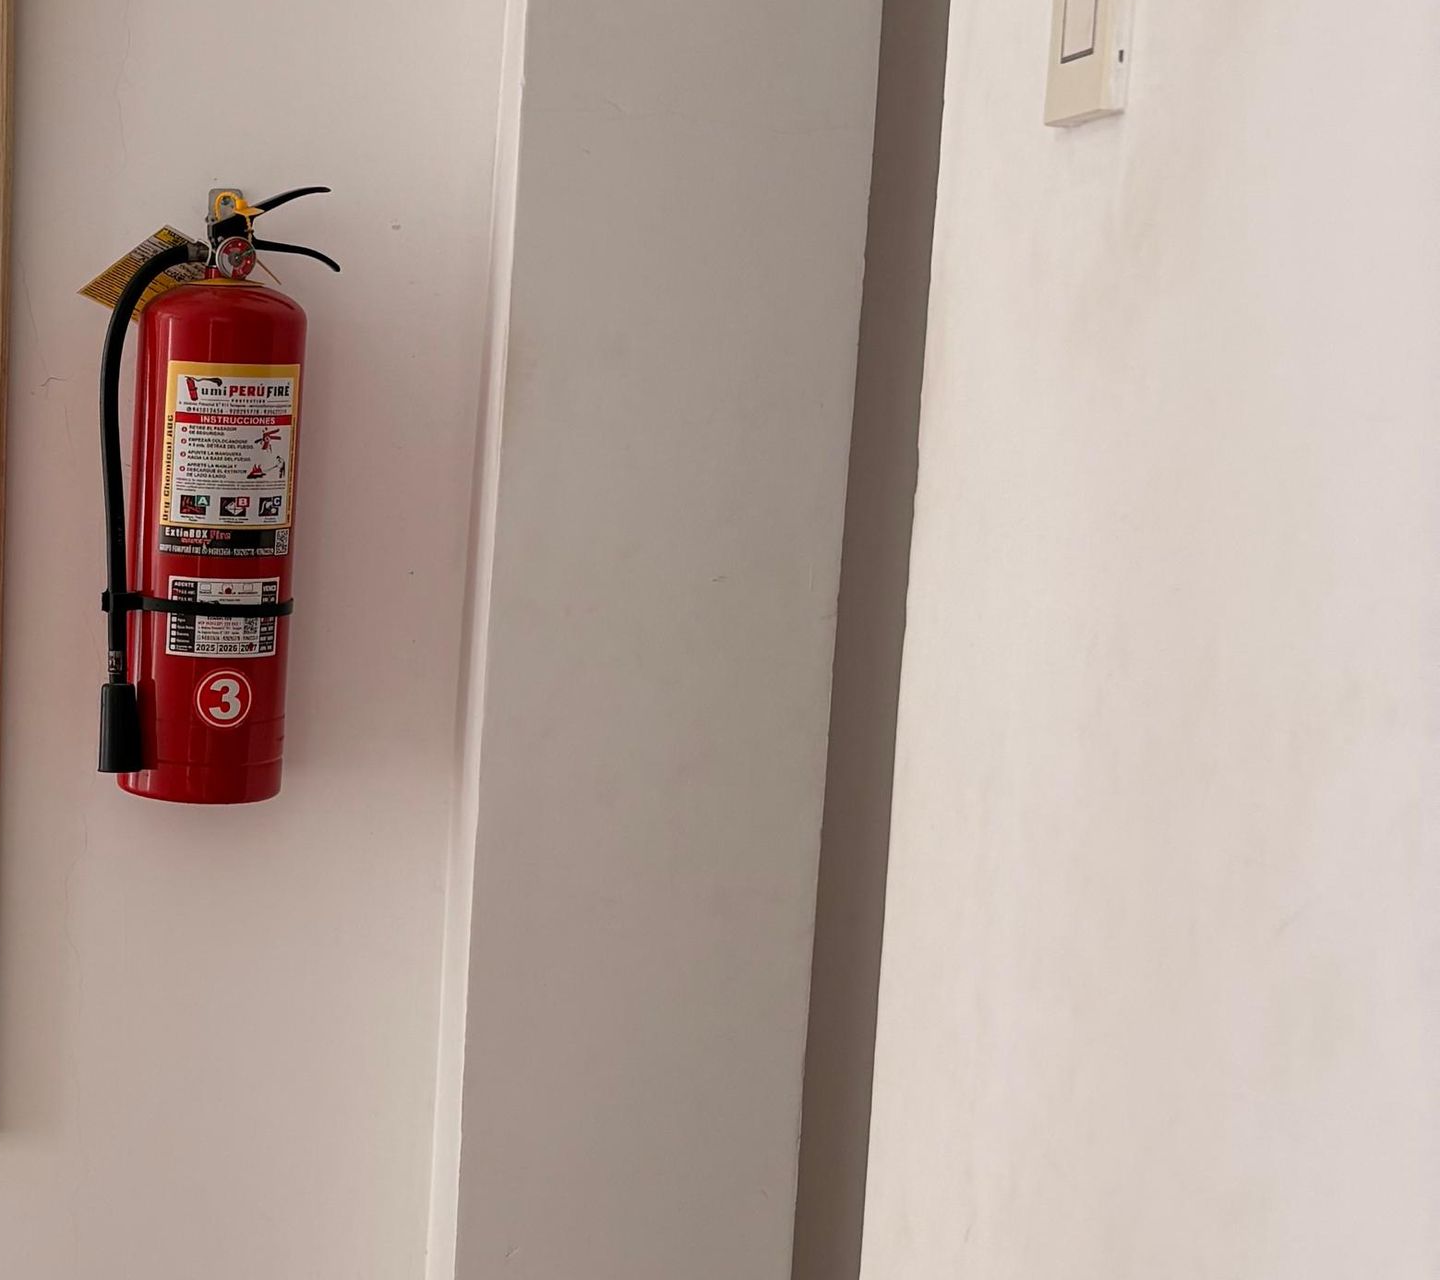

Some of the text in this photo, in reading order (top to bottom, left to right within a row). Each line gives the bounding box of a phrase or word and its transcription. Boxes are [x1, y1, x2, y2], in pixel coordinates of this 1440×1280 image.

[229, 384, 265, 397] PERÚ
[267, 385, 290, 398] FIRE
[200, 415, 276, 425] INSTRUCCIONES
[198, 497, 208, 505] A
[196, 644, 216, 652] 2025
[219, 644, 238, 652] 2026
[209, 678, 241, 720] 3
